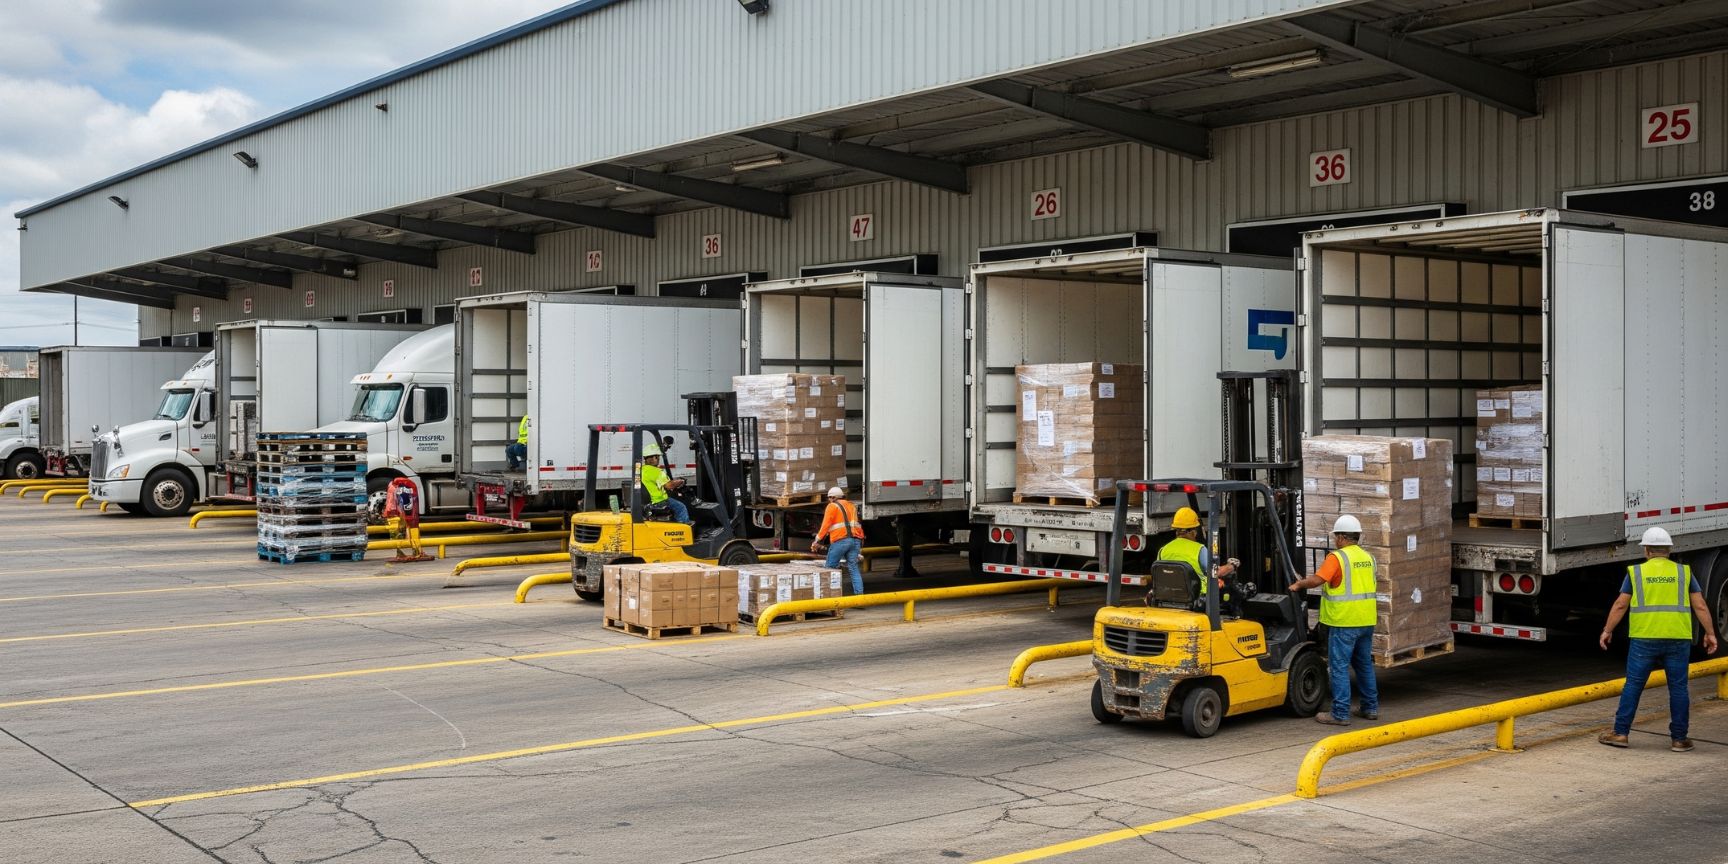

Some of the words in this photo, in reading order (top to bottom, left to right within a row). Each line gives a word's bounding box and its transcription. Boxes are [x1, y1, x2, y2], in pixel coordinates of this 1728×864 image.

[1648, 109, 1691, 143] 25
[1315, 154, 1345, 182] 36
[1035, 192, 1057, 217] 26
[1689, 190, 1715, 212] 38
[853, 217, 870, 238] 47
[706, 237, 718, 255] 36
